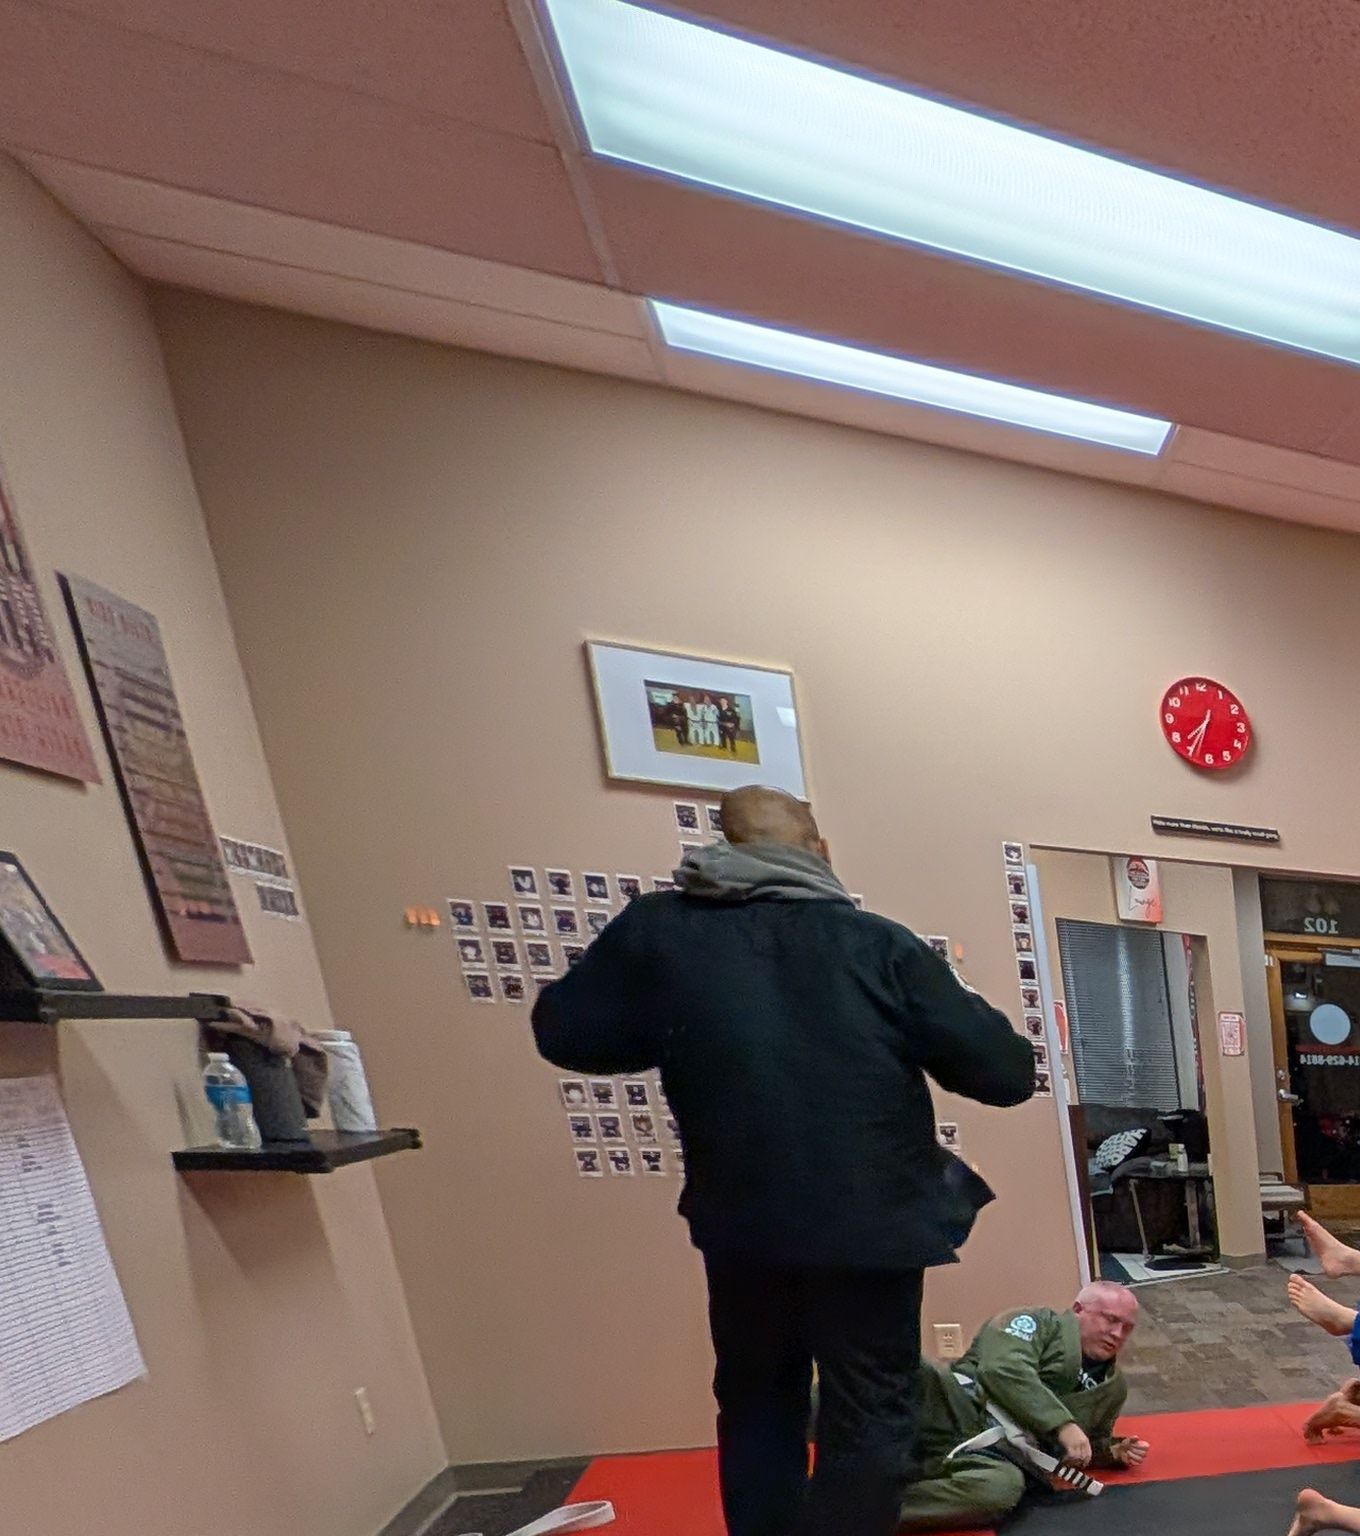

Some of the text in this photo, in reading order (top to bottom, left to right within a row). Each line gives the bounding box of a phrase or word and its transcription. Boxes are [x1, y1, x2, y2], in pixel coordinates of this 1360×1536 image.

[1180, 686, 1189, 696] 11
[1195, 682, 1207, 692] 12
[1217, 690, 1224, 699] 1
[1168, 697, 1181, 707] 10
[1230, 704, 1239, 714] 2
[1165, 713, 1175, 724] 9
[1236, 722, 1246, 733] 3
[1172, 732, 1181, 743] 8
[1234, 738, 1242, 749] 4
[1205, 753, 1214, 764] 6
[1222, 751, 1231, 761] 5
